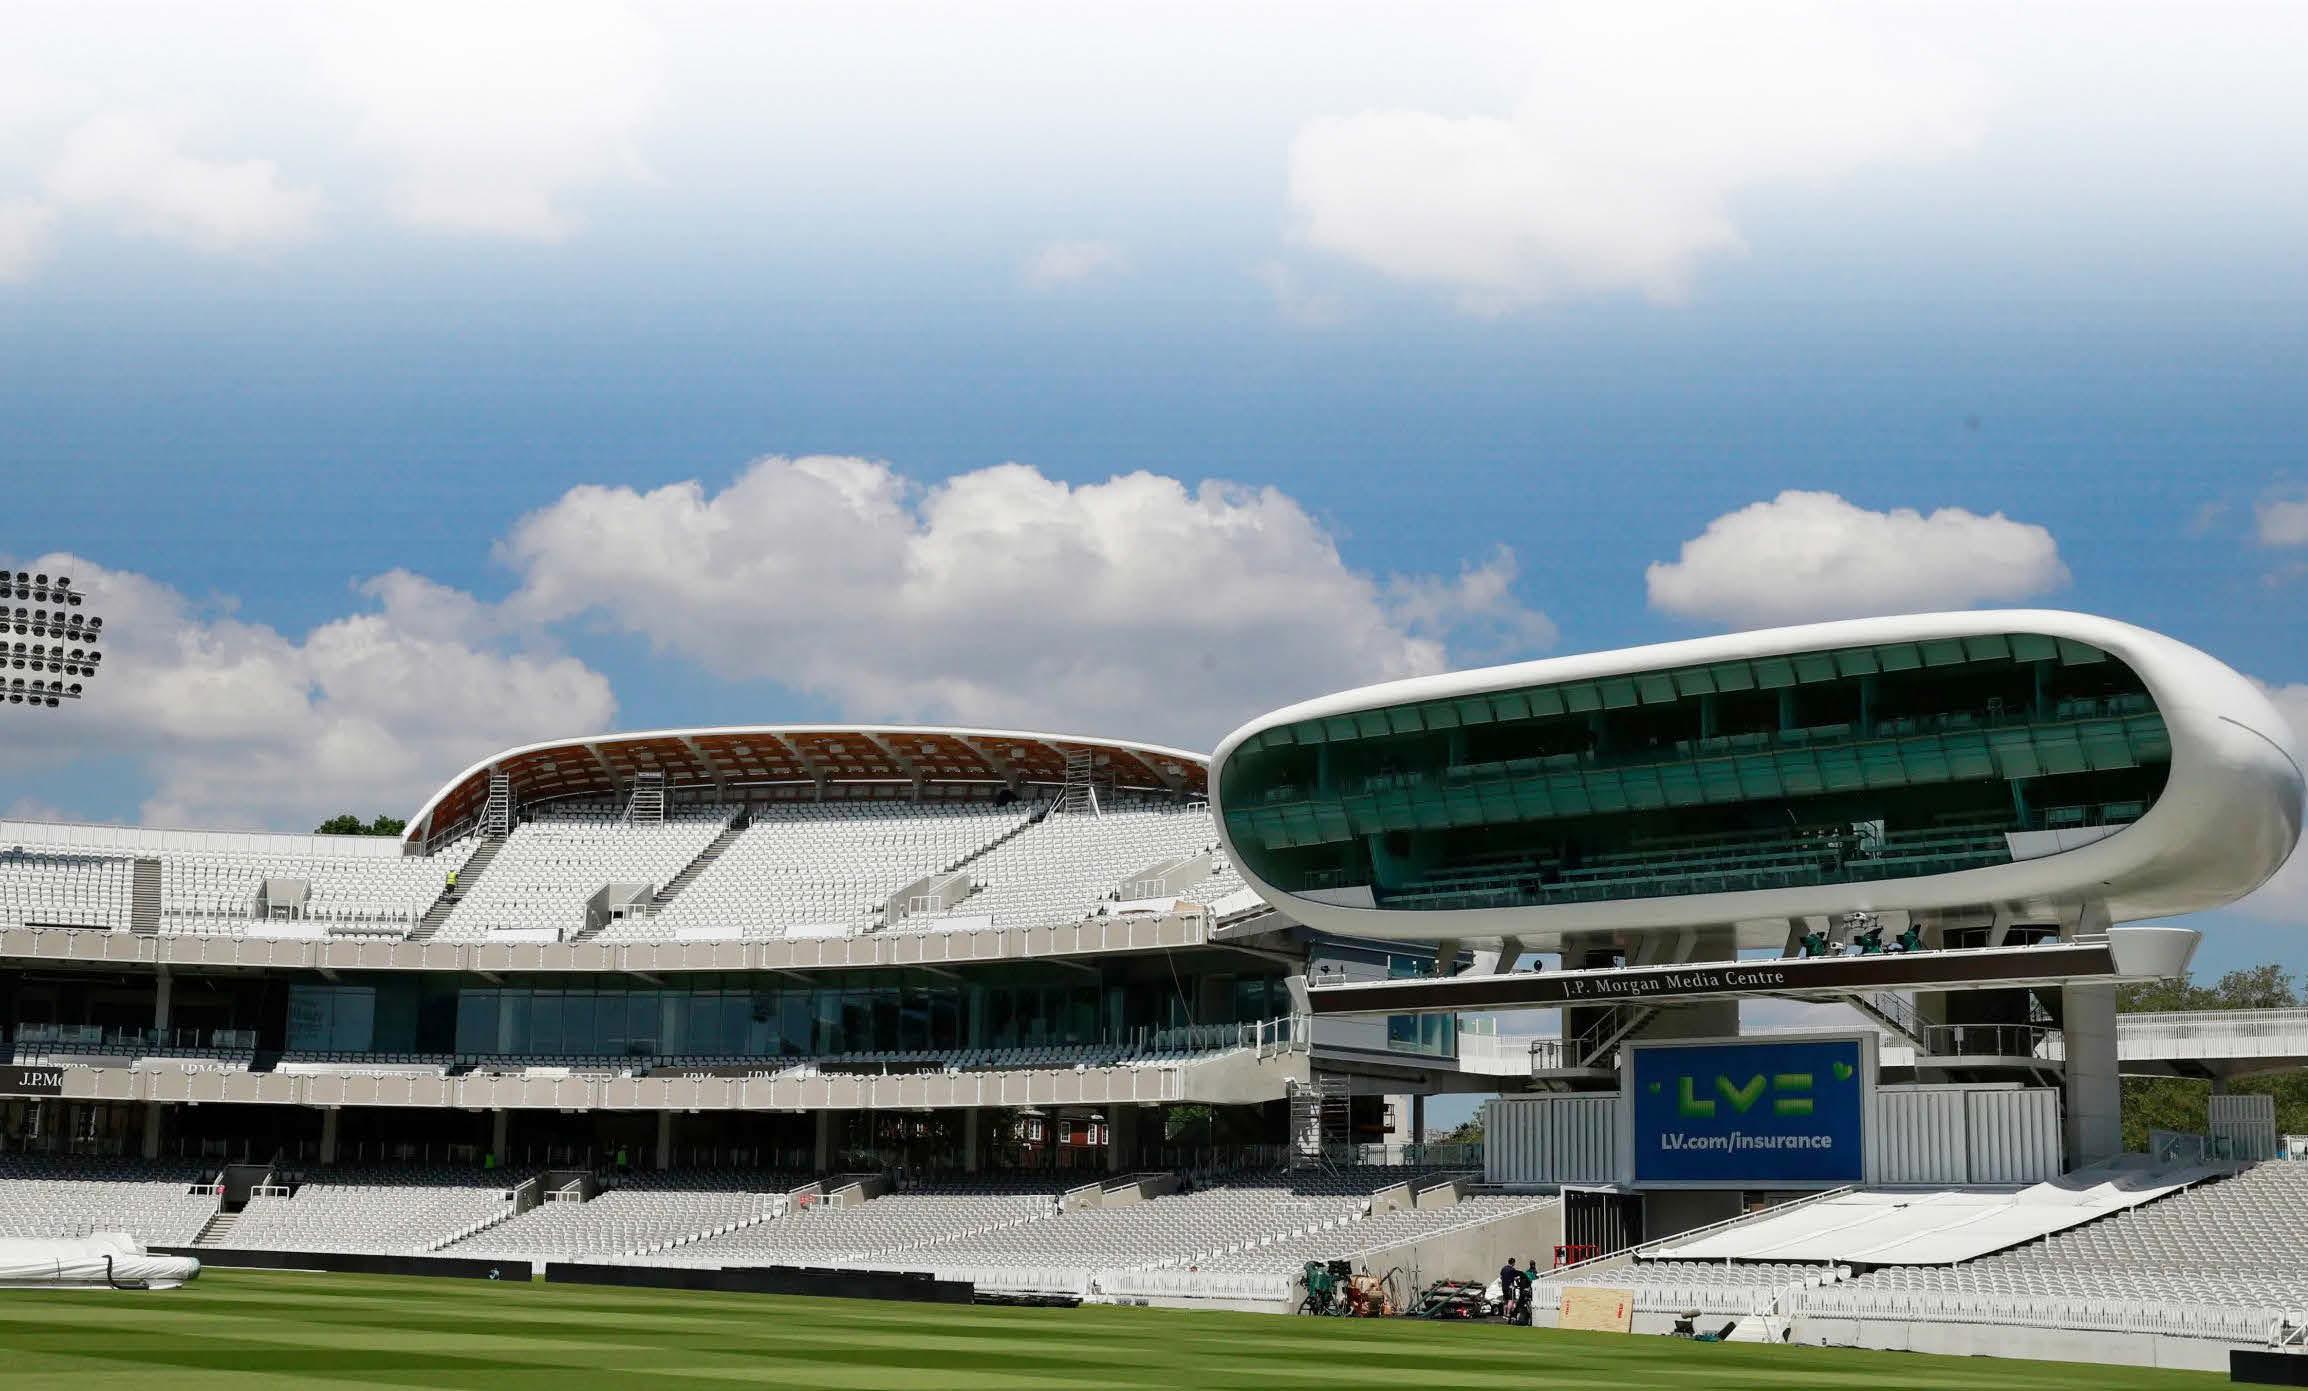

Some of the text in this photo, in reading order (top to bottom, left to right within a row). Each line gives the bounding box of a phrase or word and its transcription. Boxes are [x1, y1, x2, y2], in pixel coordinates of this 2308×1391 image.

[1562, 971, 1785, 998] J.P. Morgan Media Centre
[1661, 1131, 1832, 1153] LV.com/insurance
